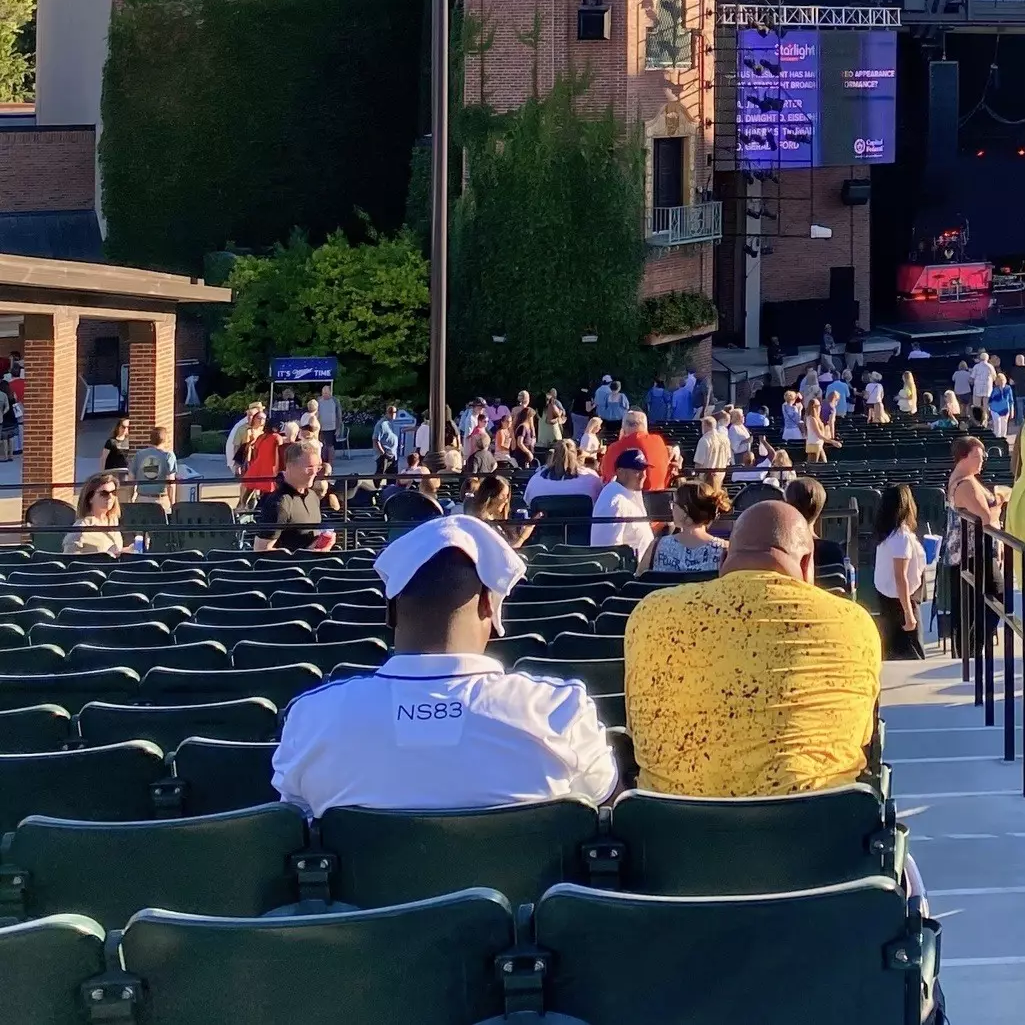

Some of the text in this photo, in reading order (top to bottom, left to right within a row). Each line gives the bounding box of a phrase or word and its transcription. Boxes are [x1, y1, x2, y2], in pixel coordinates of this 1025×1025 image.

[855, 70, 894, 78] APPEARANCE
[745, 115, 776, 123] DWIGHT
[314, 369, 332, 377] TIME
[397, 701, 463, 721] NS83
